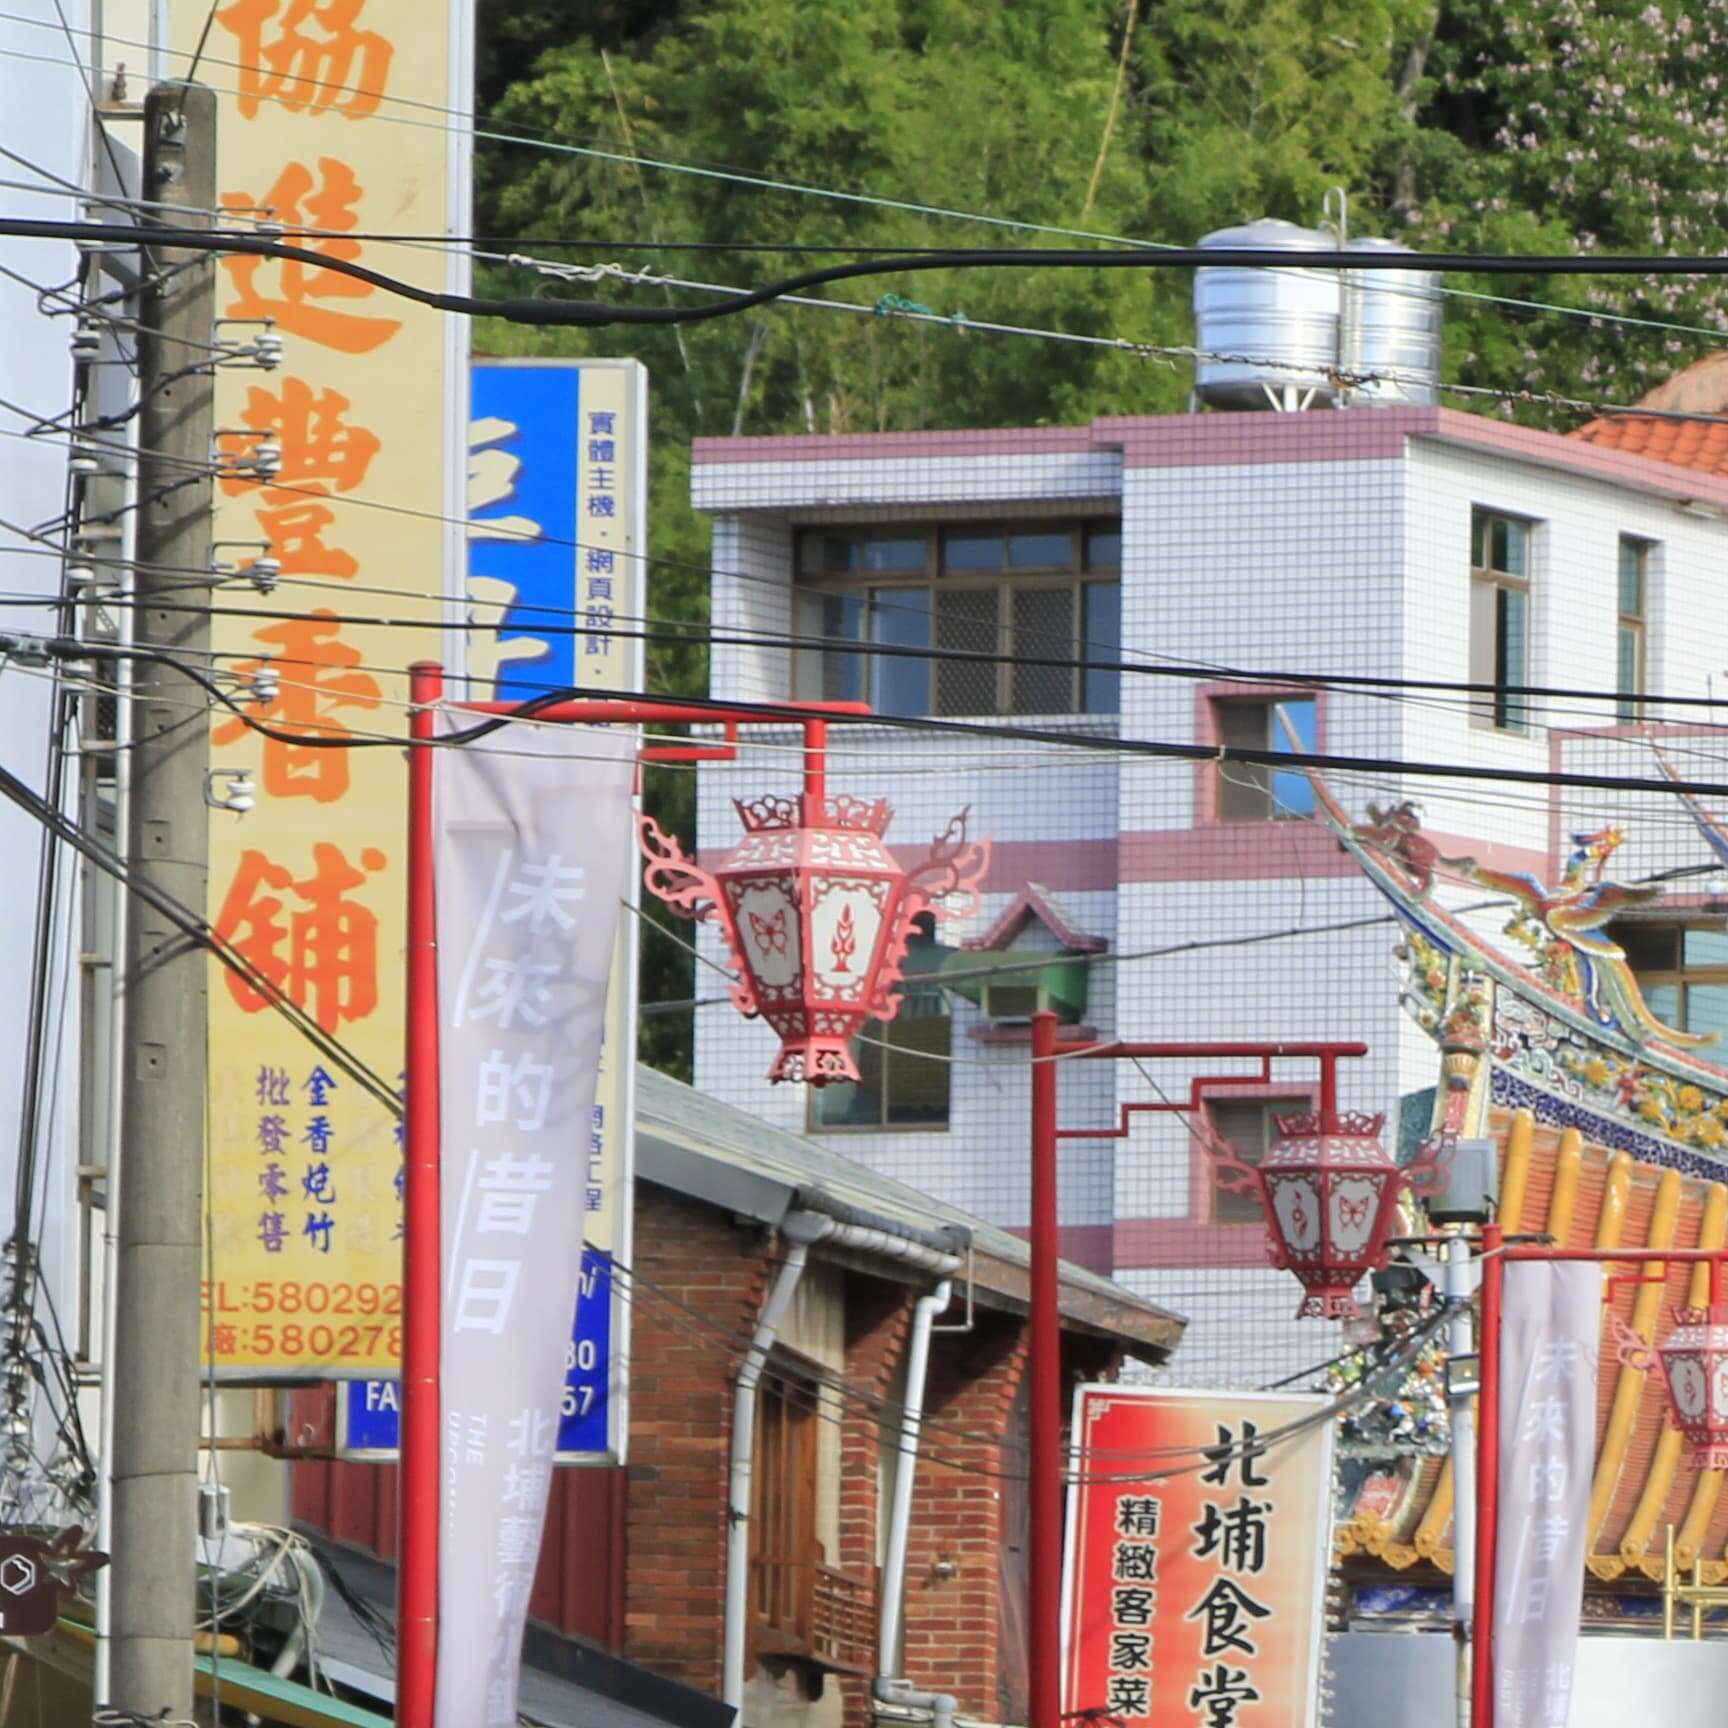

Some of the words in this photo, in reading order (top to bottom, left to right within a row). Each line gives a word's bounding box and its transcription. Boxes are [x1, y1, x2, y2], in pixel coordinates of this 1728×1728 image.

[255, 1064, 293, 1255] 批發零售
[452, 855, 584, 1336] 未來的昔日
[1106, 1496, 1161, 1719] 精緻客家菜
